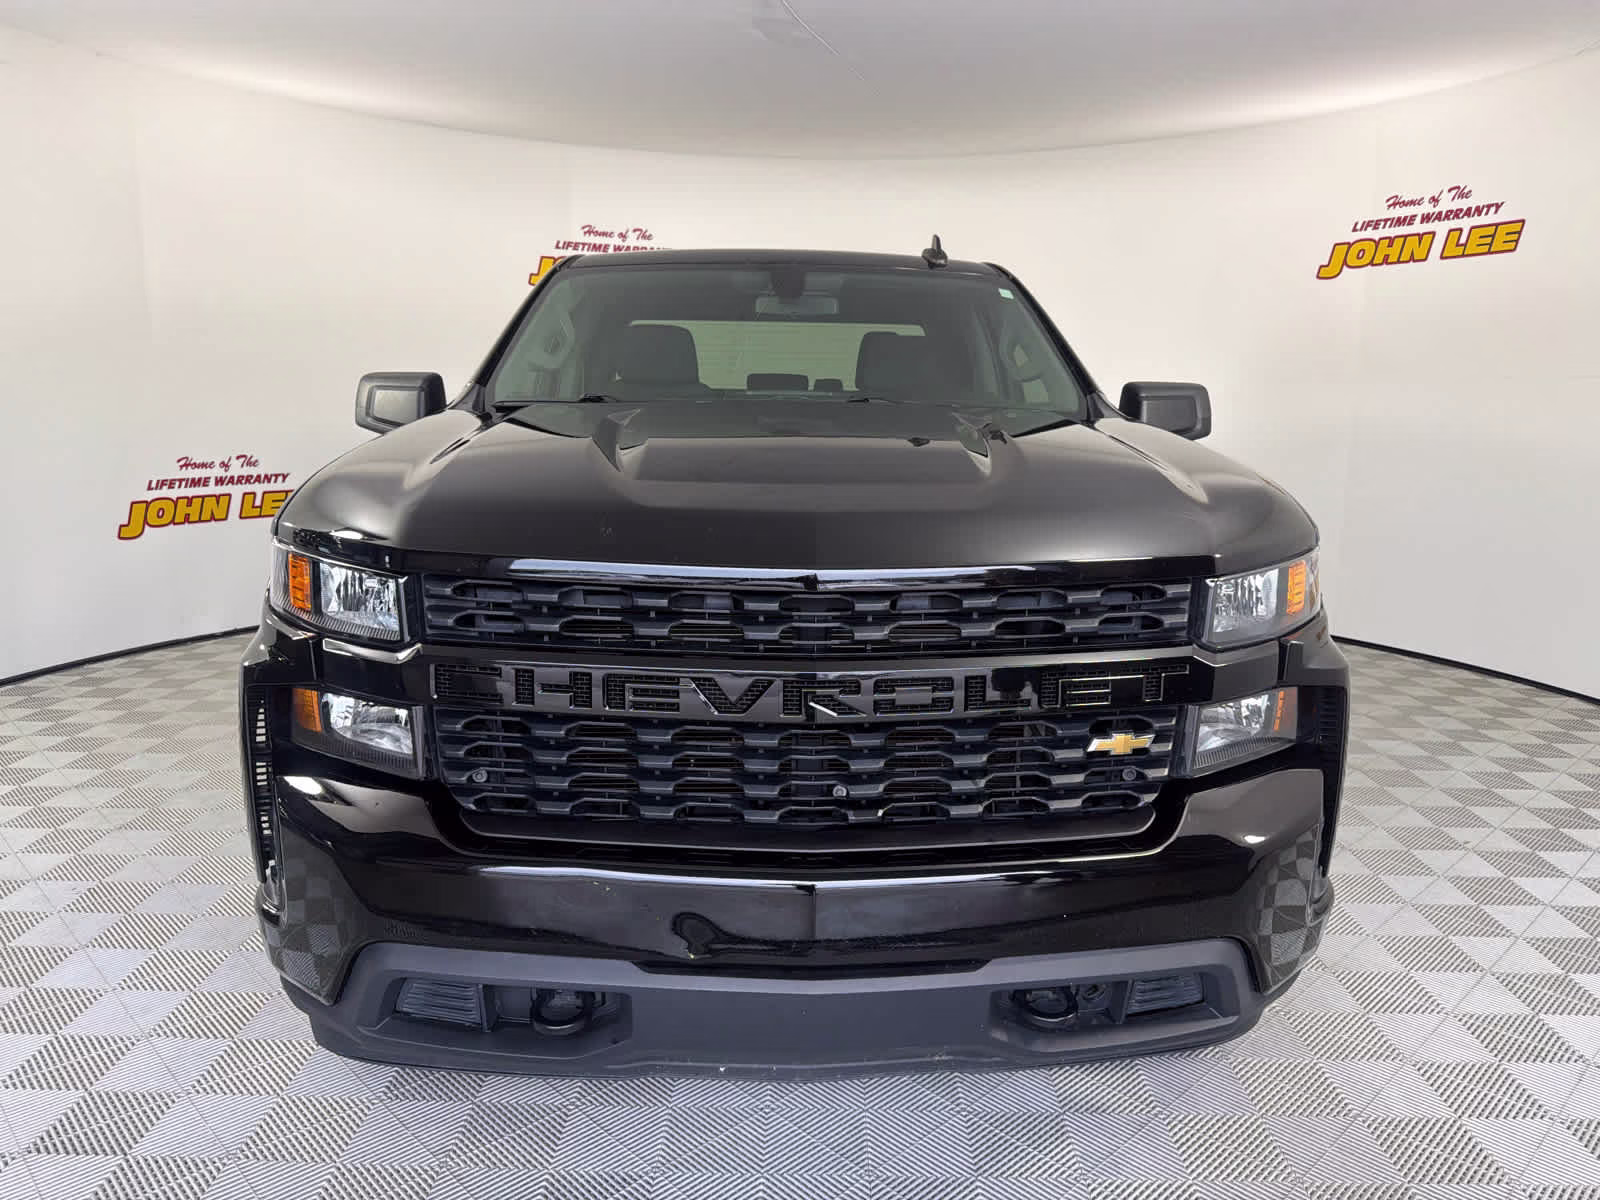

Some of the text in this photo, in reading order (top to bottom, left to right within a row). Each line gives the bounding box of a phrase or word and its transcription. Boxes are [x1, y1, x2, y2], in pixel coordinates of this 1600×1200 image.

[1385, 185, 1473, 210] Home of The
[1352, 202, 1505, 233] LIFETIME WARRANTY
[581, 224, 654, 243] Home of The
[555, 240, 611, 254] LIFETIME
[1316, 219, 1526, 280] JOHN LEE
[176, 454, 259, 473] Home of The
[147, 473, 290, 491] LIFETIME WARRANTY
[118, 489, 294, 541] JOHN LE
[432, 662, 1190, 718] CHEVROLET
